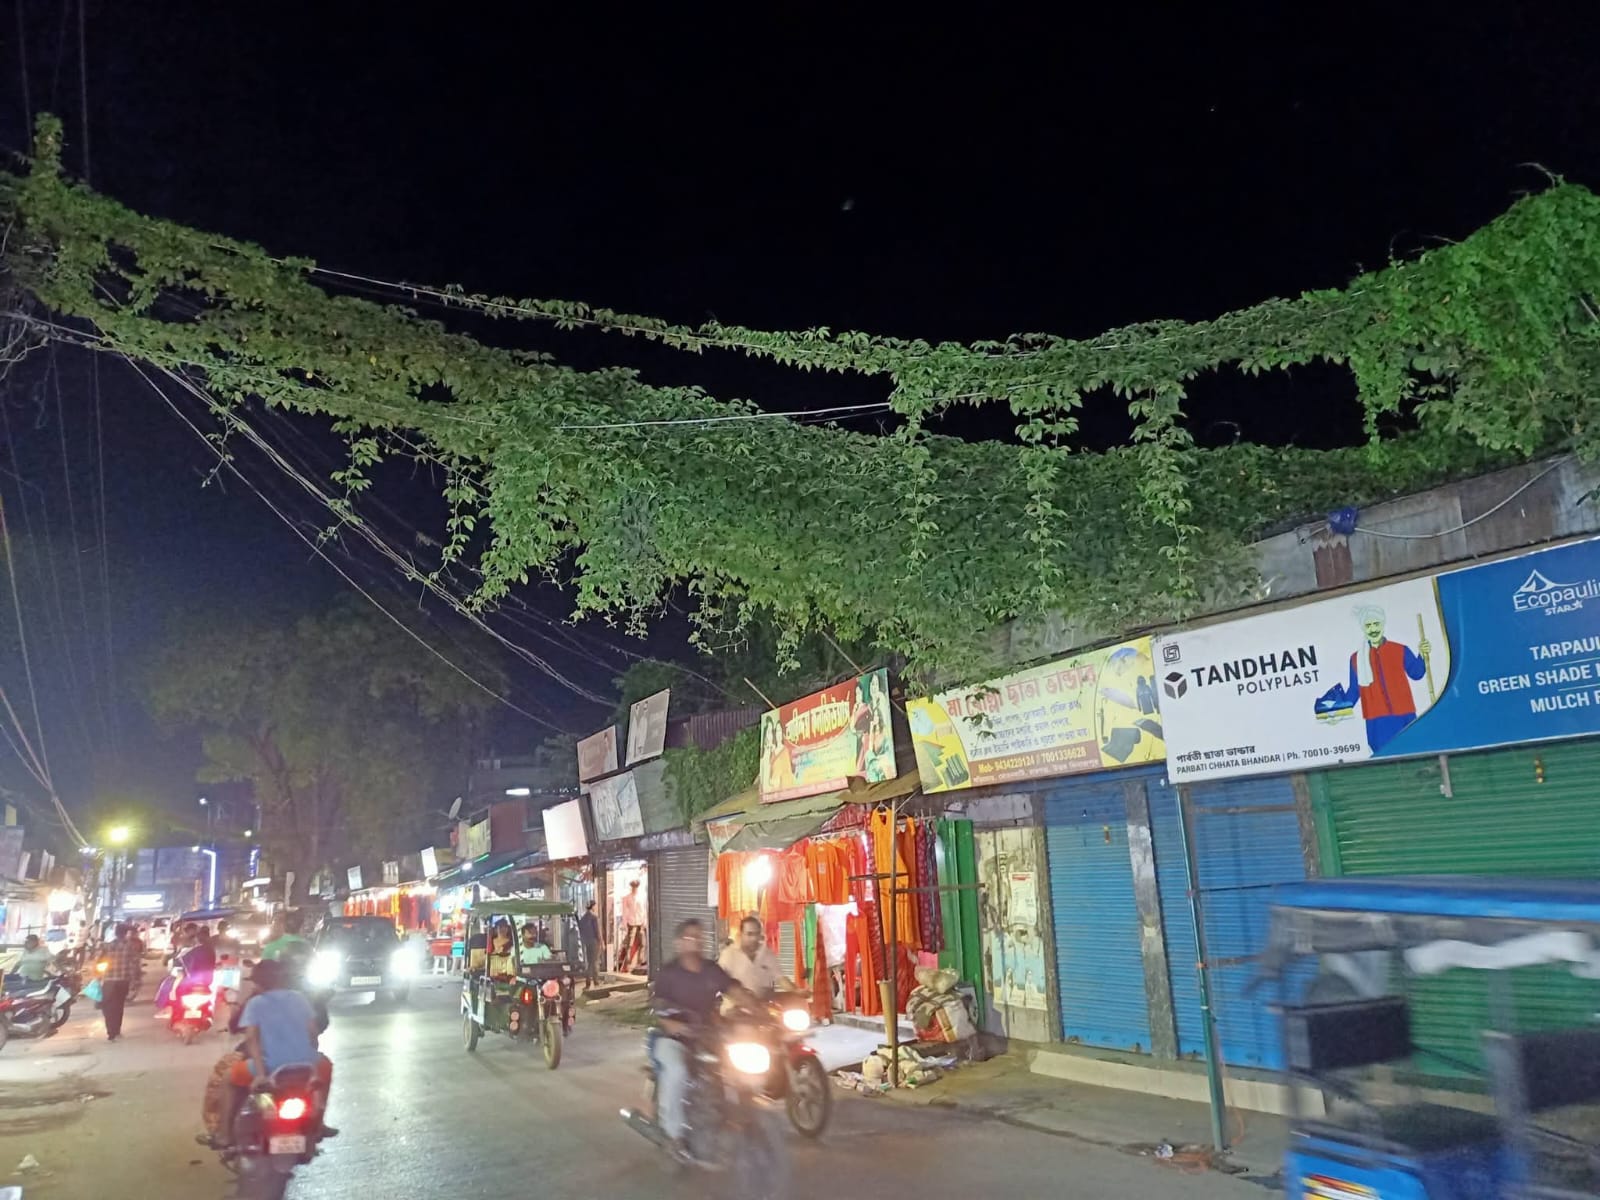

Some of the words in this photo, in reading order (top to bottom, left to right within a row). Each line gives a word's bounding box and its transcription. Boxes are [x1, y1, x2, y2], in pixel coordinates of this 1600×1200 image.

[1513, 579, 1600, 609] Ecopauli
[1545, 604, 1574, 616] STAR
[1191, 645, 1318, 687] TANDHAN
[1478, 674, 1531, 694] GREEN
[1535, 664, 1592, 686] SHADE
[1237, 669, 1320, 696] POLYPLAST
[1530, 691, 1590, 713] MULCH
[1176, 762, 1207, 774] PARBATI
[1208, 759, 1241, 770] CHHATA
[1241, 753, 1281, 767] BHANDAR
[1287, 751, 1300, 761] Ph.
[1302, 743, 1361, 759] 70010-39699
